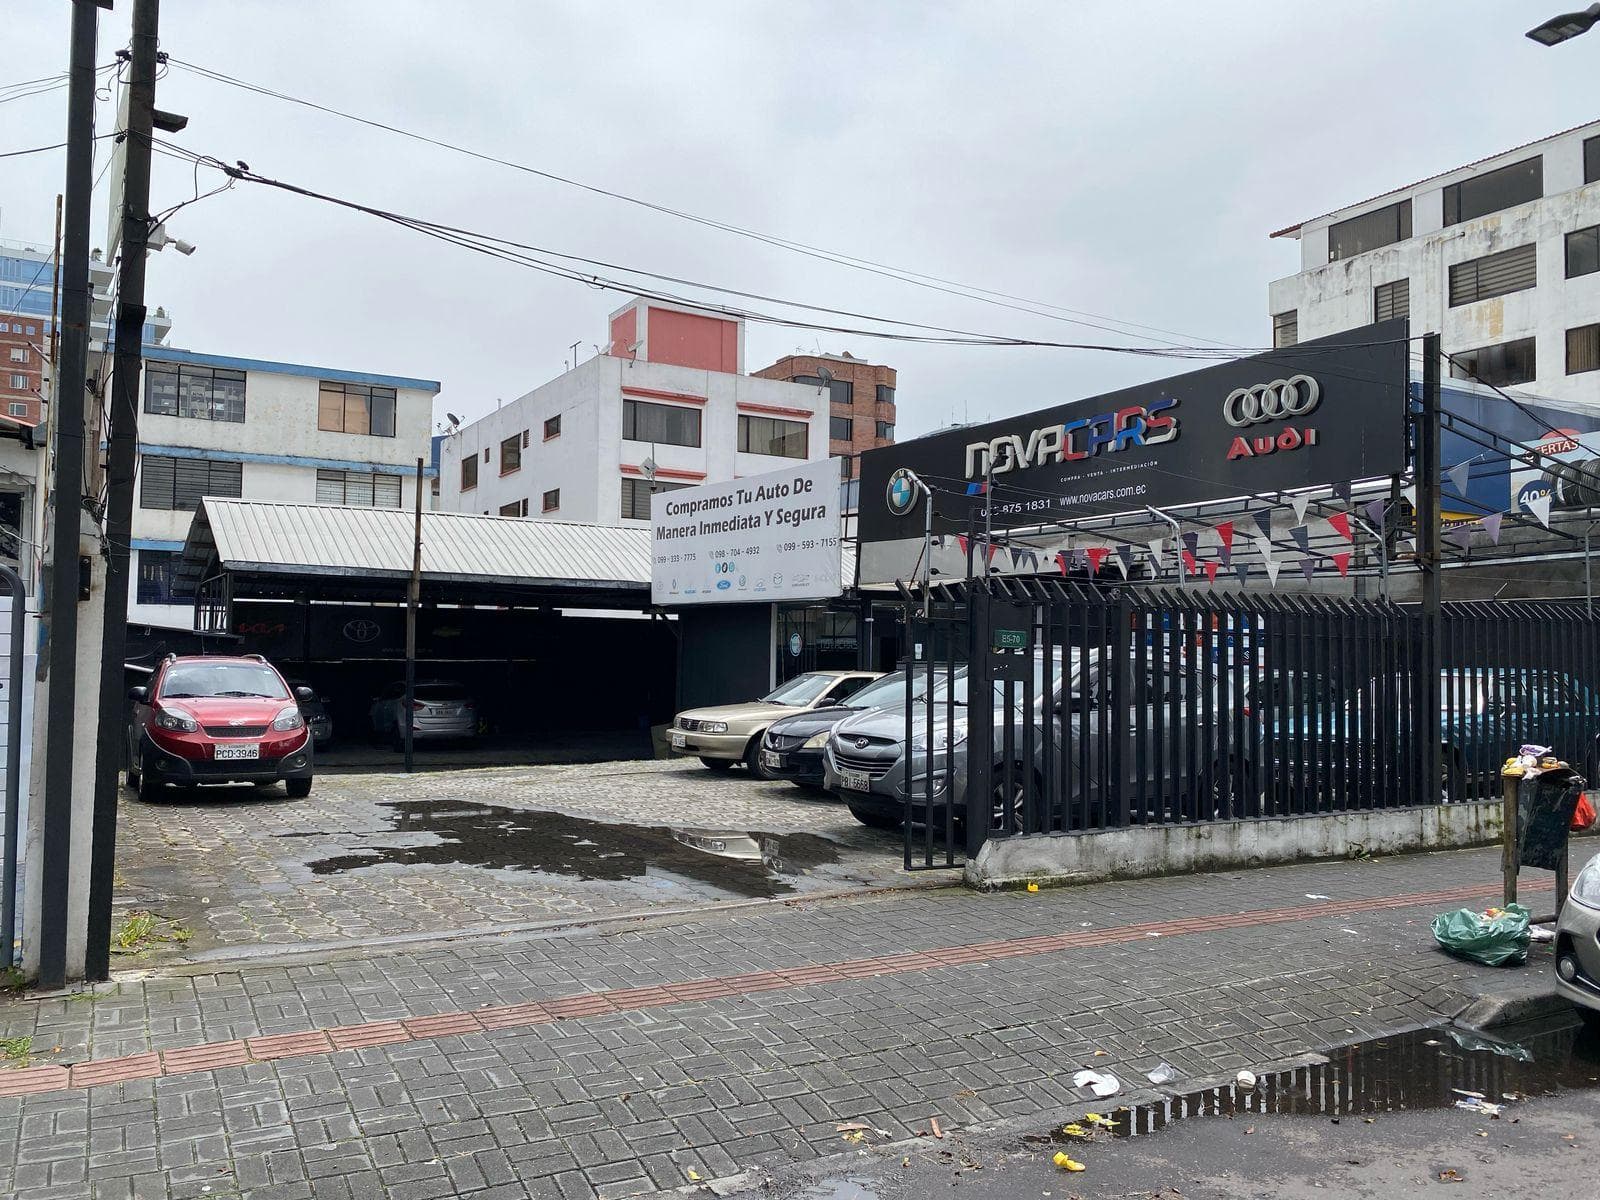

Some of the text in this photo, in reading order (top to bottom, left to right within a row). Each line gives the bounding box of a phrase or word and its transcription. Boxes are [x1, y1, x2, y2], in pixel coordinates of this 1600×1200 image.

[965, 398, 1179, 480] NOVACARS
[666, 477, 813, 518] Compramos Tu Auto De
[1025, 499, 1051, 512] 1831
[1060, 483, 1147, 507] www.novacars.com.ec
[656, 504, 826, 541] Manera Inmediata Y Segura
